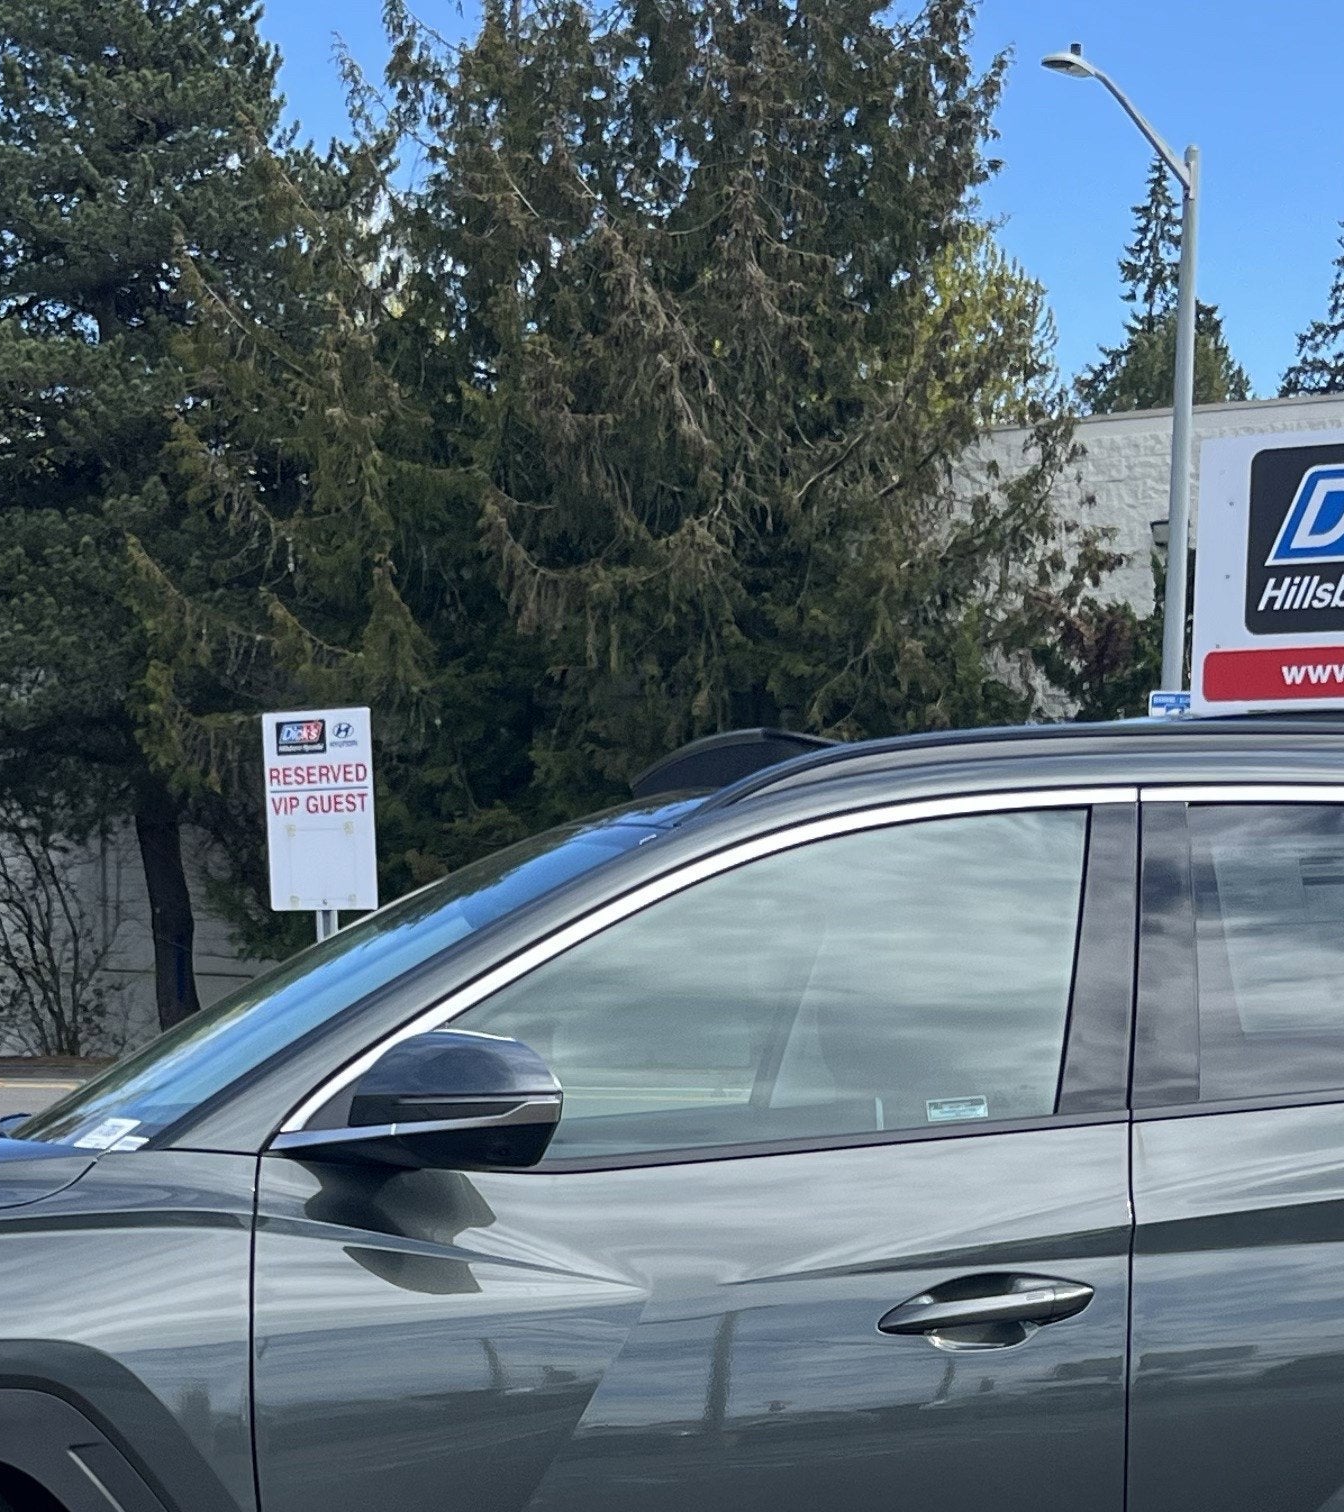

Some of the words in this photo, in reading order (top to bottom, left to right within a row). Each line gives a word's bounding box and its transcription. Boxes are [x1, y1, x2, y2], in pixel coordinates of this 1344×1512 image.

[269, 763, 367, 786] RESERVED
[271, 797, 300, 815] VIP
[306, 793, 368, 814] GUEST
